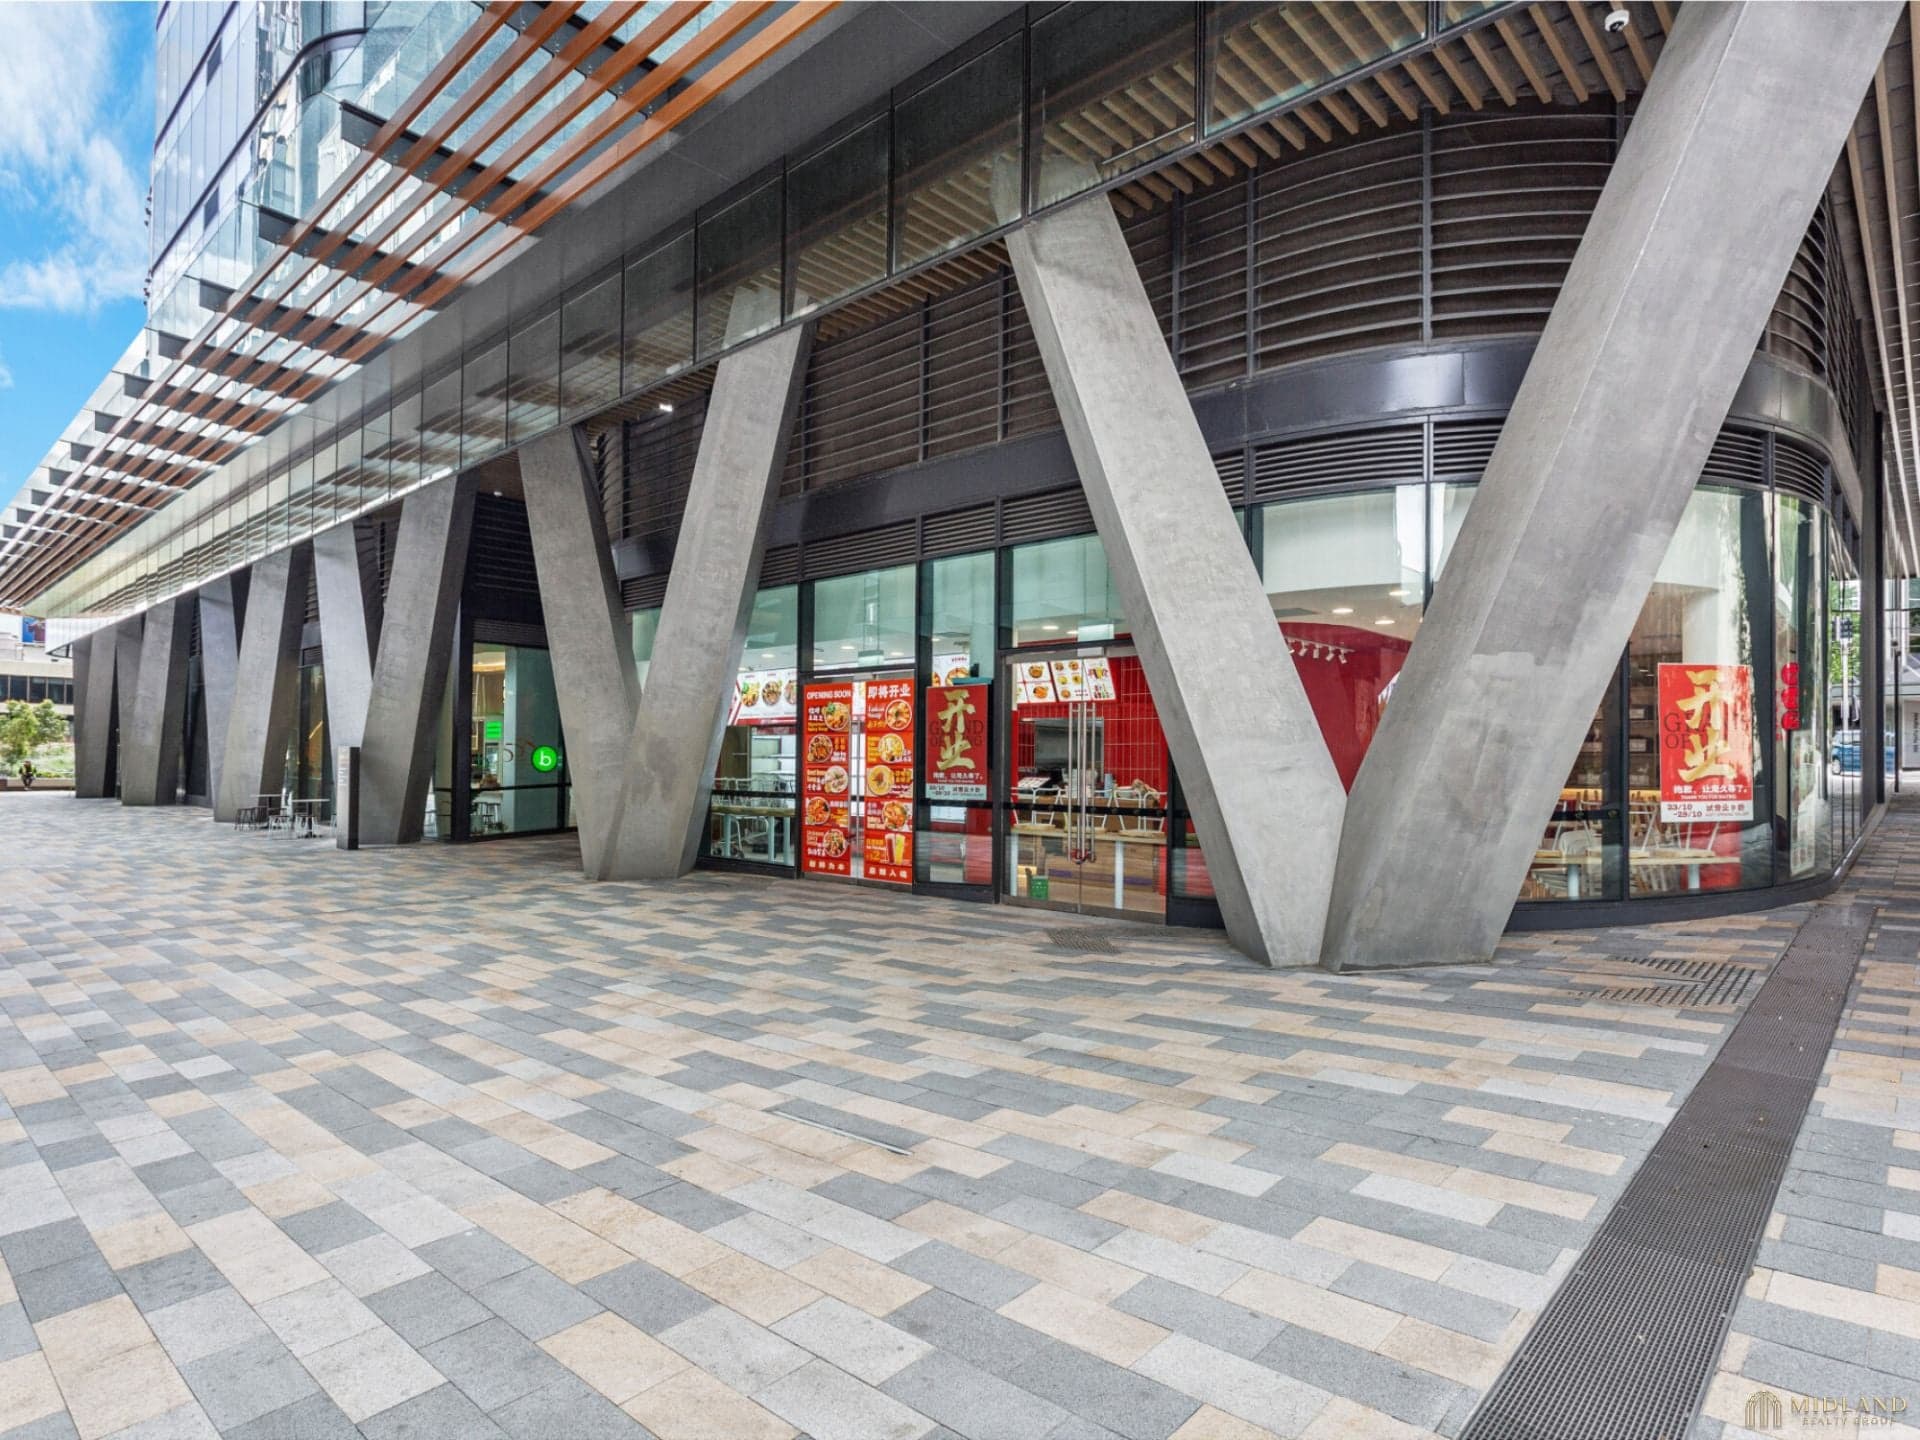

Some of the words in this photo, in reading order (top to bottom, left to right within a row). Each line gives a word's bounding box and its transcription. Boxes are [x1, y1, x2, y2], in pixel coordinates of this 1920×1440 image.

[806, 691, 833, 700] OPENING
[834, 690, 851, 699] SOON
[867, 683, 911, 698] 即将开业
[936, 689, 976, 770] 开业
[1676, 669, 1737, 783] 开业
